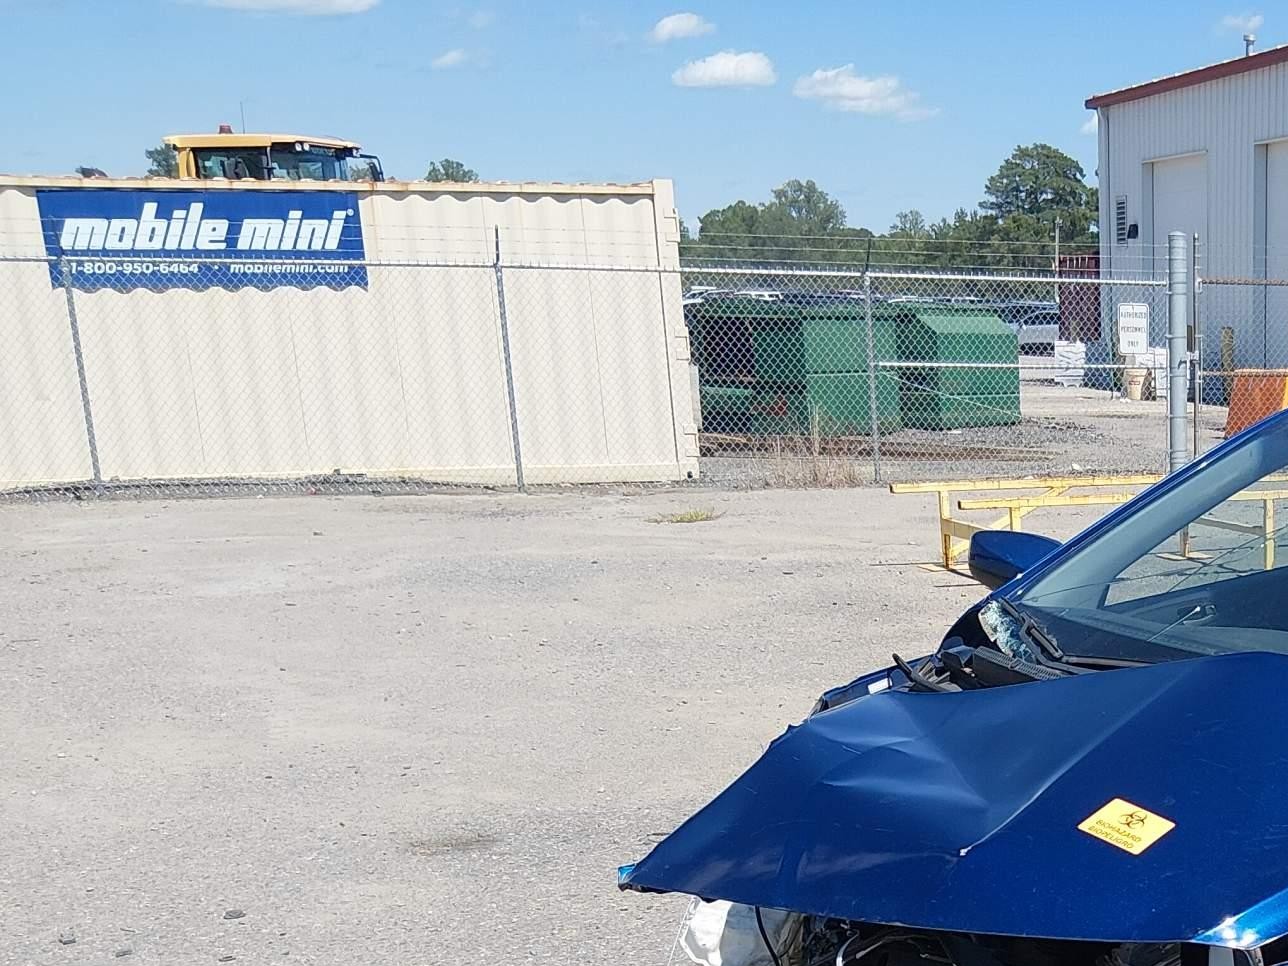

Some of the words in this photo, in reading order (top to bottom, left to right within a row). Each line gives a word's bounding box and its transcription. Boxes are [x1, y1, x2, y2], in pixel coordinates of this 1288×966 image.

[60, 202, 229, 250] mobile
[236, 210, 346, 250] mini
[1096, 819, 1142, 842] BIOHAZARD
